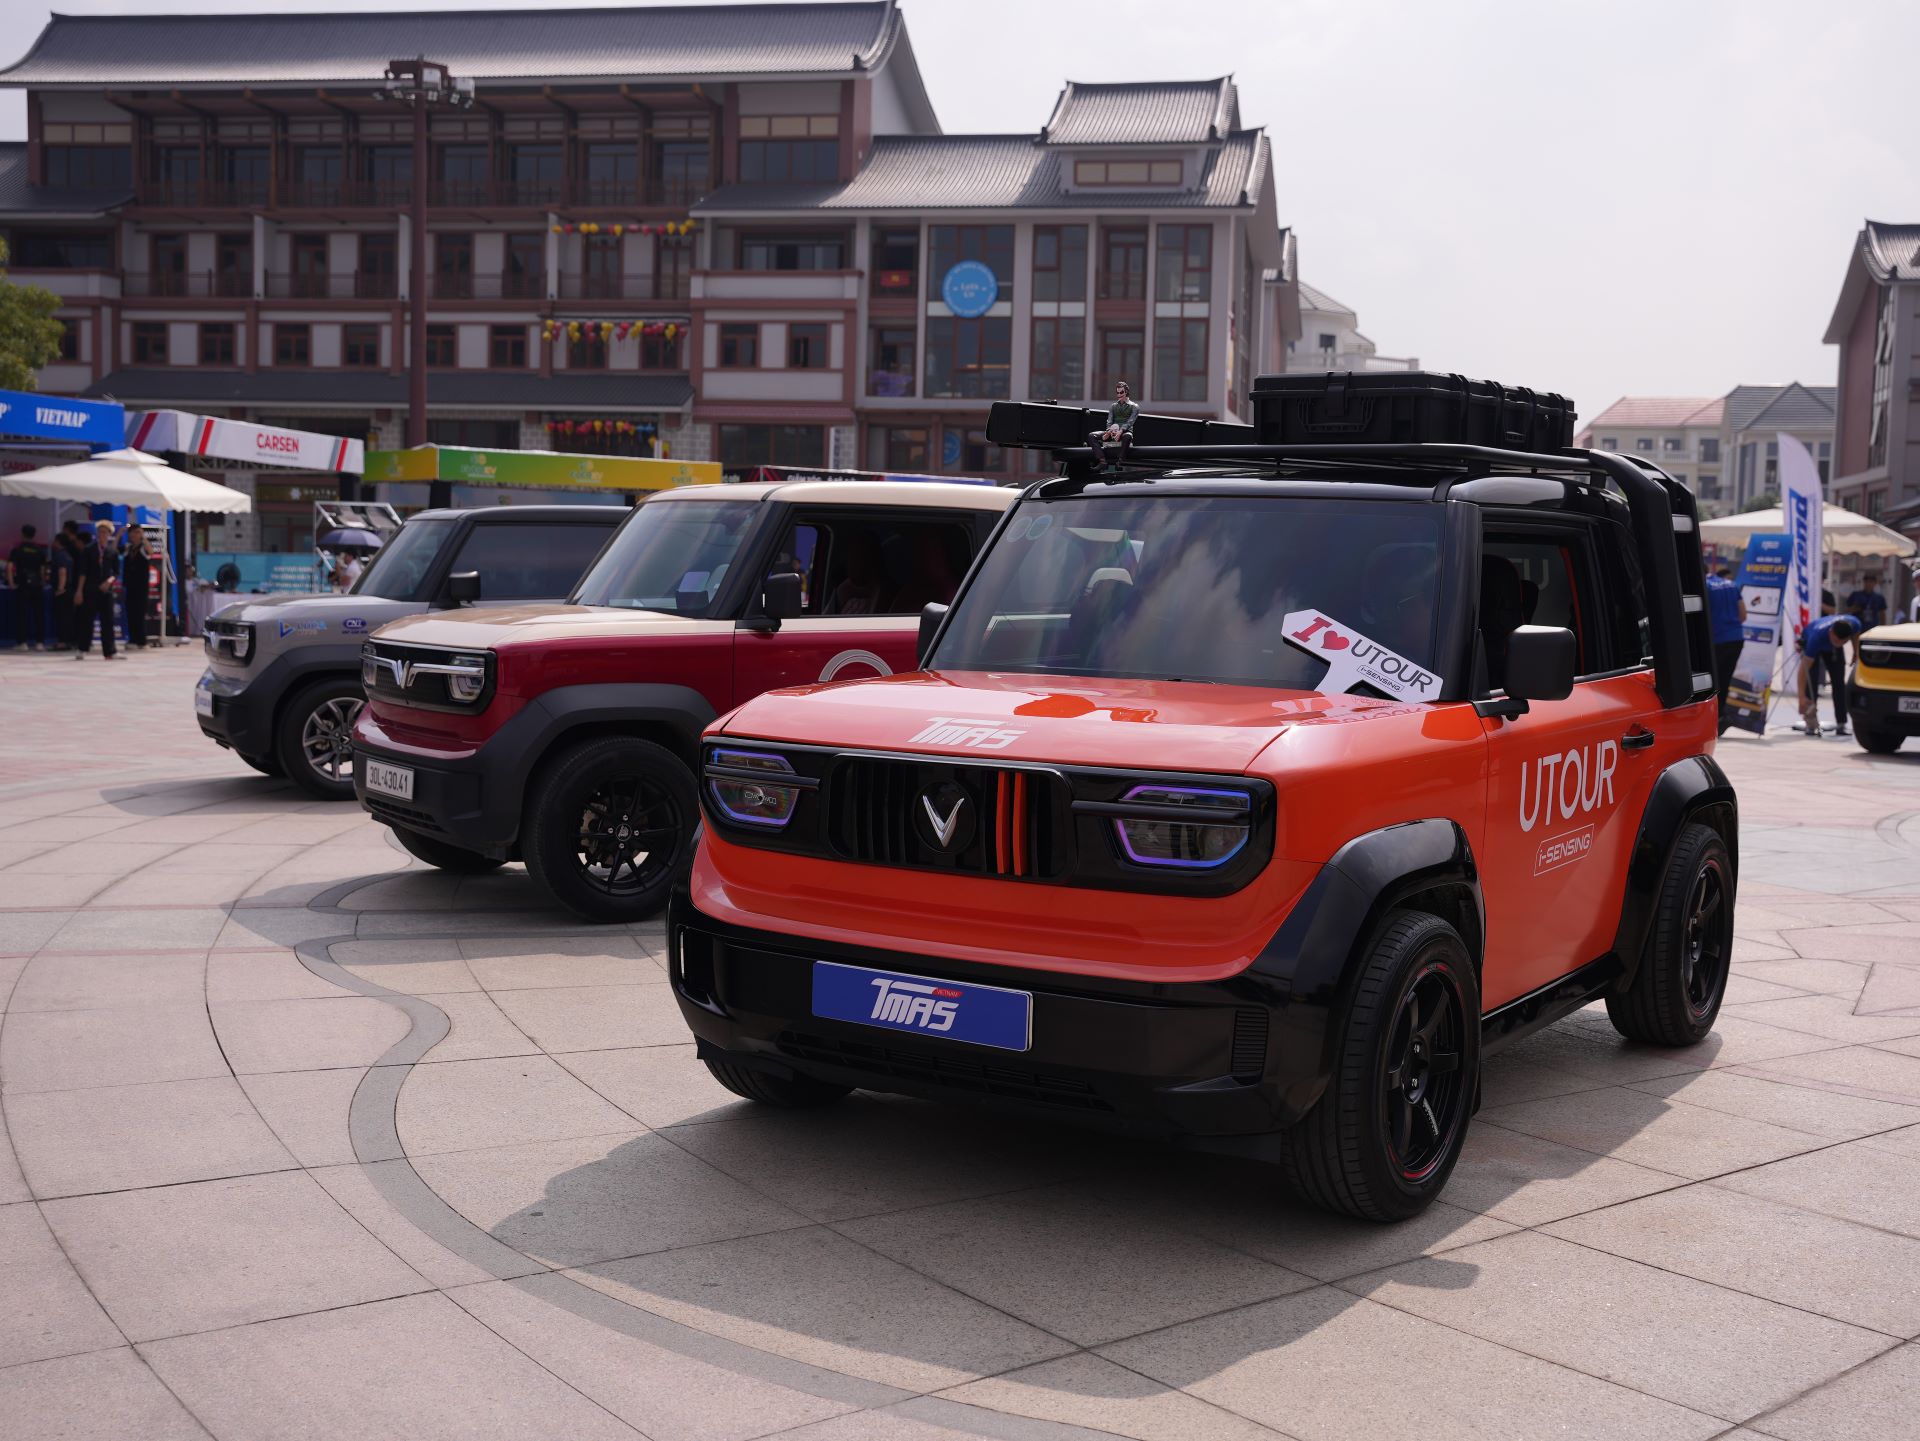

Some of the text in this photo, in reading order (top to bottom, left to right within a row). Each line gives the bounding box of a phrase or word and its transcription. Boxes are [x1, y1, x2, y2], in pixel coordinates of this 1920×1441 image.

[36, 407, 87, 428] VIETMAP
[255, 433, 300, 453] CARSEN
[1292, 616, 1434, 694] I UTOUR
[906, 716, 1028, 749] TMAS
[369, 765, 408, 793] 30L-430.41
[1519, 739, 1618, 833] UTOUR
[1538, 833, 1592, 867] i-SENSING
[870, 978, 960, 1032] TMAS
